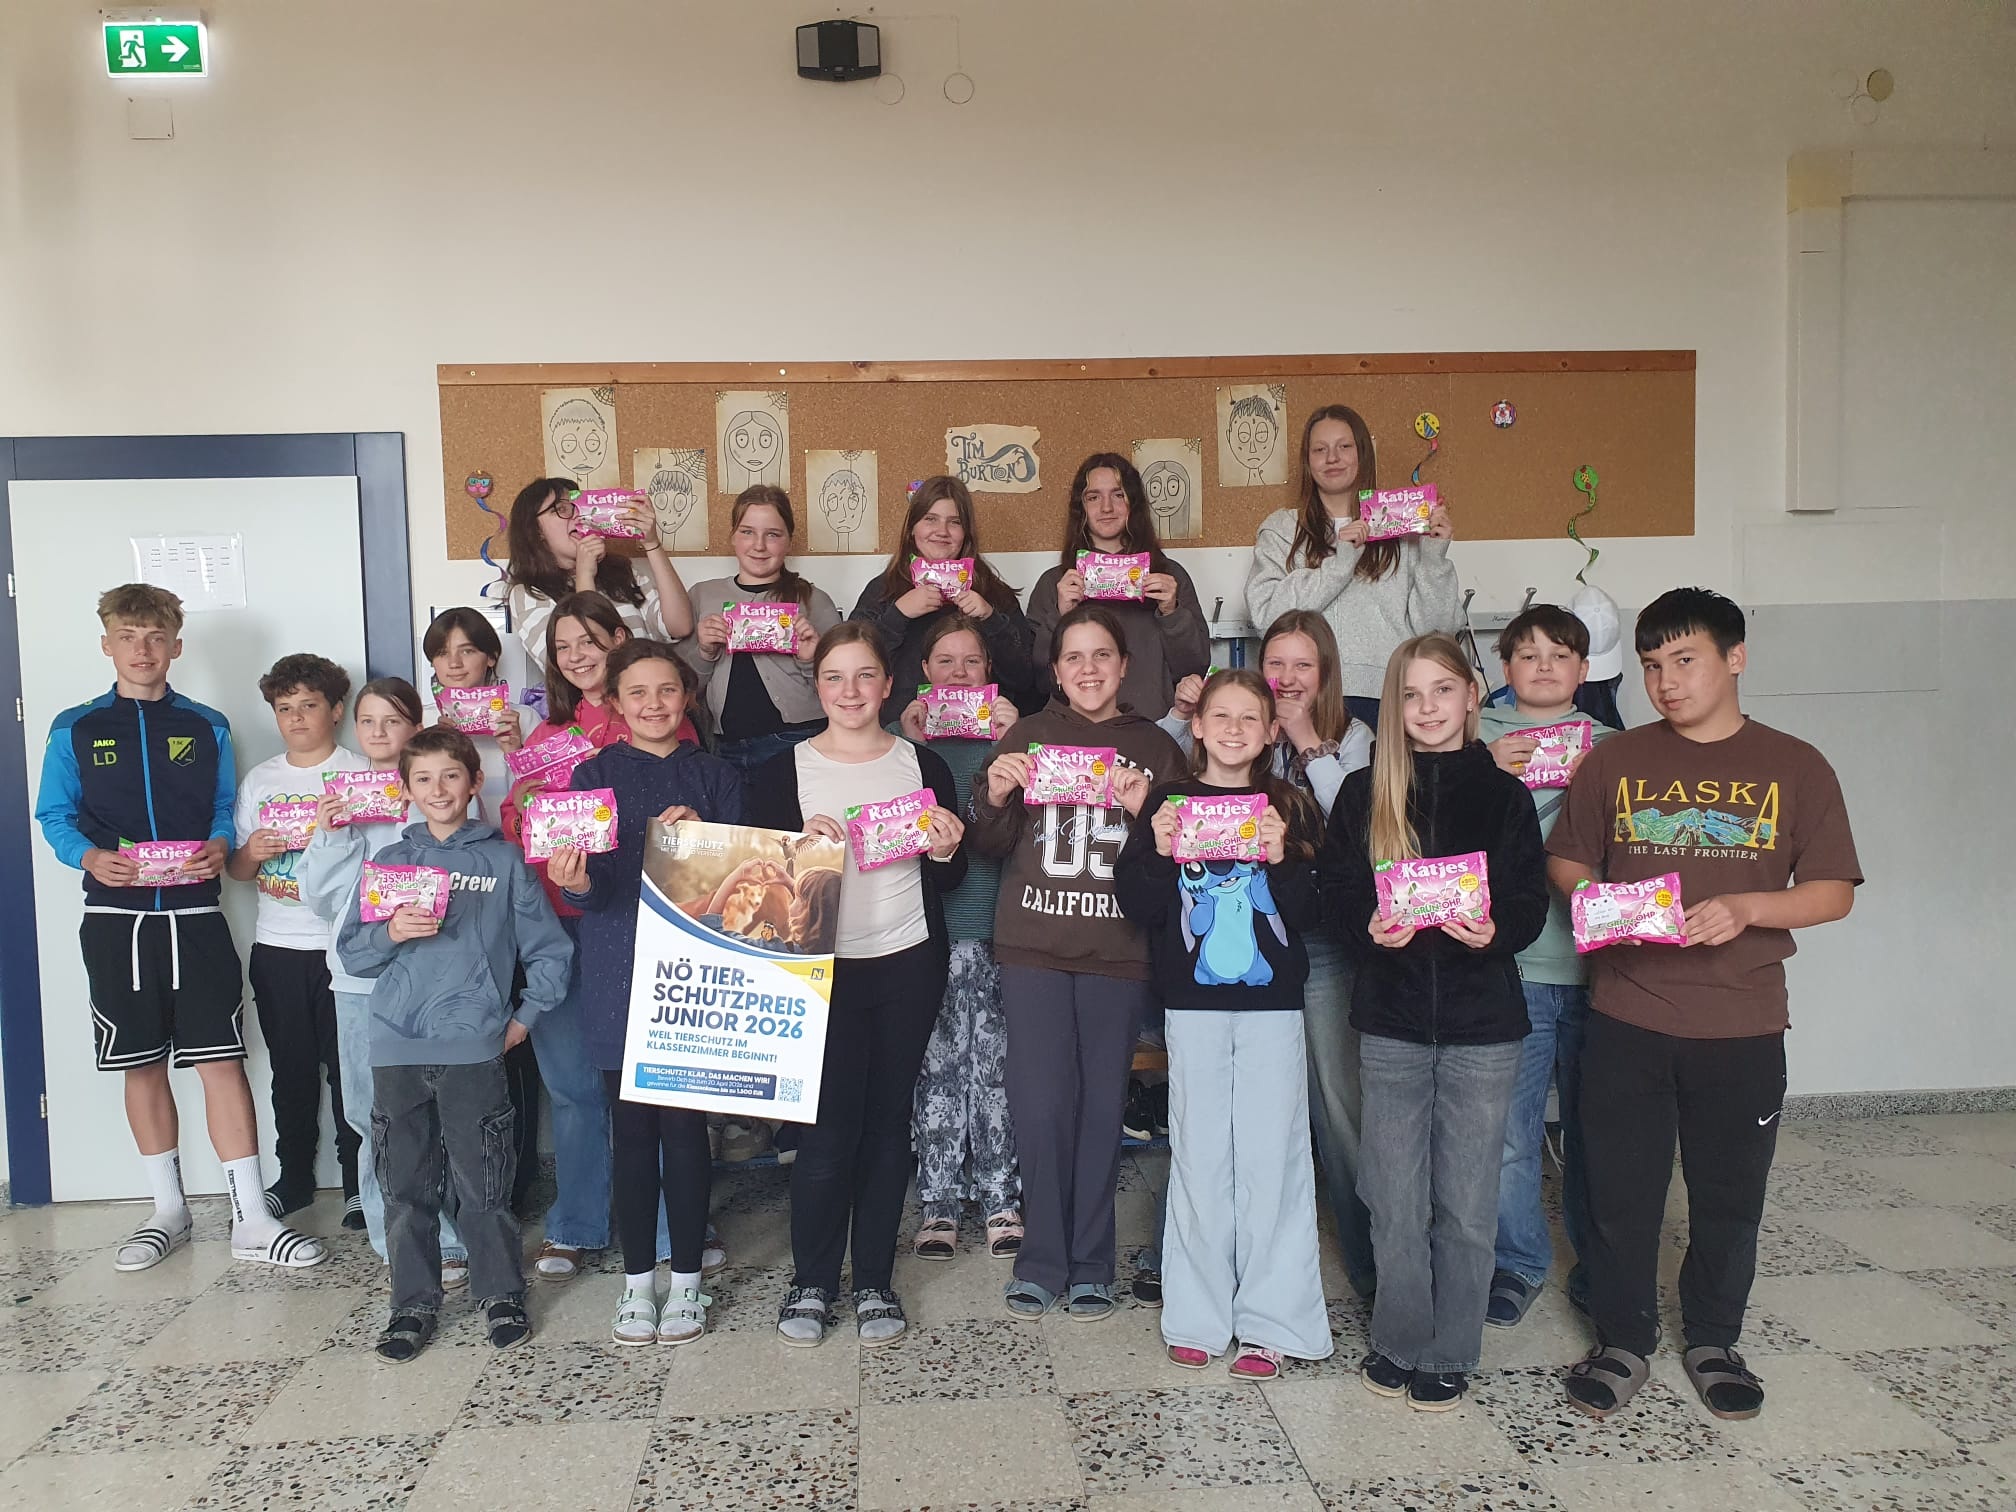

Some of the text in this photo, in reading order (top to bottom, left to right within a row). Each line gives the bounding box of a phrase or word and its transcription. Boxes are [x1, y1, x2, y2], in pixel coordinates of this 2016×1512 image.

[951, 432, 985, 463] TIM
[957, 456, 1022, 484] BURTON
[1377, 489, 1424, 503] Katjes
[921, 560, 965, 572] Katjes
[1095, 553, 1138, 567] Katjes
[1102, 587, 1126, 597] HASE
[740, 605, 785, 618] Katjes
[450, 688, 498, 701] Katjes
[937, 689, 985, 702] Katjes
[947, 725, 973, 736] HASE
[93, 739, 116, 747] JAKO
[93, 751, 117, 766] LD
[1049, 749, 1102, 764] Katjes
[344, 772, 395, 784] Katjes
[1059, 792, 1086, 801] HASE
[541, 796, 603, 813] Katjes
[868, 799, 922, 821] Katjes
[1191, 801, 1251, 818] Katjes
[268, 808, 316, 818] Katjes
[1614, 776, 1779, 850] ALASKA
[550, 831, 596, 846] GRÜN-OHR
[662, 836, 724, 850] TIERSCHUTZ
[1041, 803, 1129, 880] 05
[1198, 837, 1242, 849] GRÜN-OHR
[138, 846, 192, 860] Katjes
[890, 840, 919, 858] HASE
[1206, 845, 1237, 857] HASE
[1629, 845, 1758, 861] THE LAST FRONTIER
[1401, 861, 1469, 878] Katjes
[383, 872, 413, 883] HASE
[450, 871, 498, 893] Crew
[1598, 877, 1666, 897] Katjes
[1022, 884, 1125, 919] CALIFORN
[1413, 898, 1462, 915] GRÜN-OHR
[1421, 908, 1458, 925] HASE
[655, 957, 755, 988] NÖ TIER-
[653, 982, 806, 1017] SCHUTZPREIS
[650, 1005, 803, 1039] JUNIOR 2026
[648, 1029, 748, 1048] WEIL TIERSCHUTZ IM
[646, 1041, 778, 1063] KLASSENZIMMER BEGINNT!
[687, 1070, 708, 1079] KLAR,
[722, 1074, 754, 1083] MACHEN
[754, 1076, 771, 1084] WIR!
